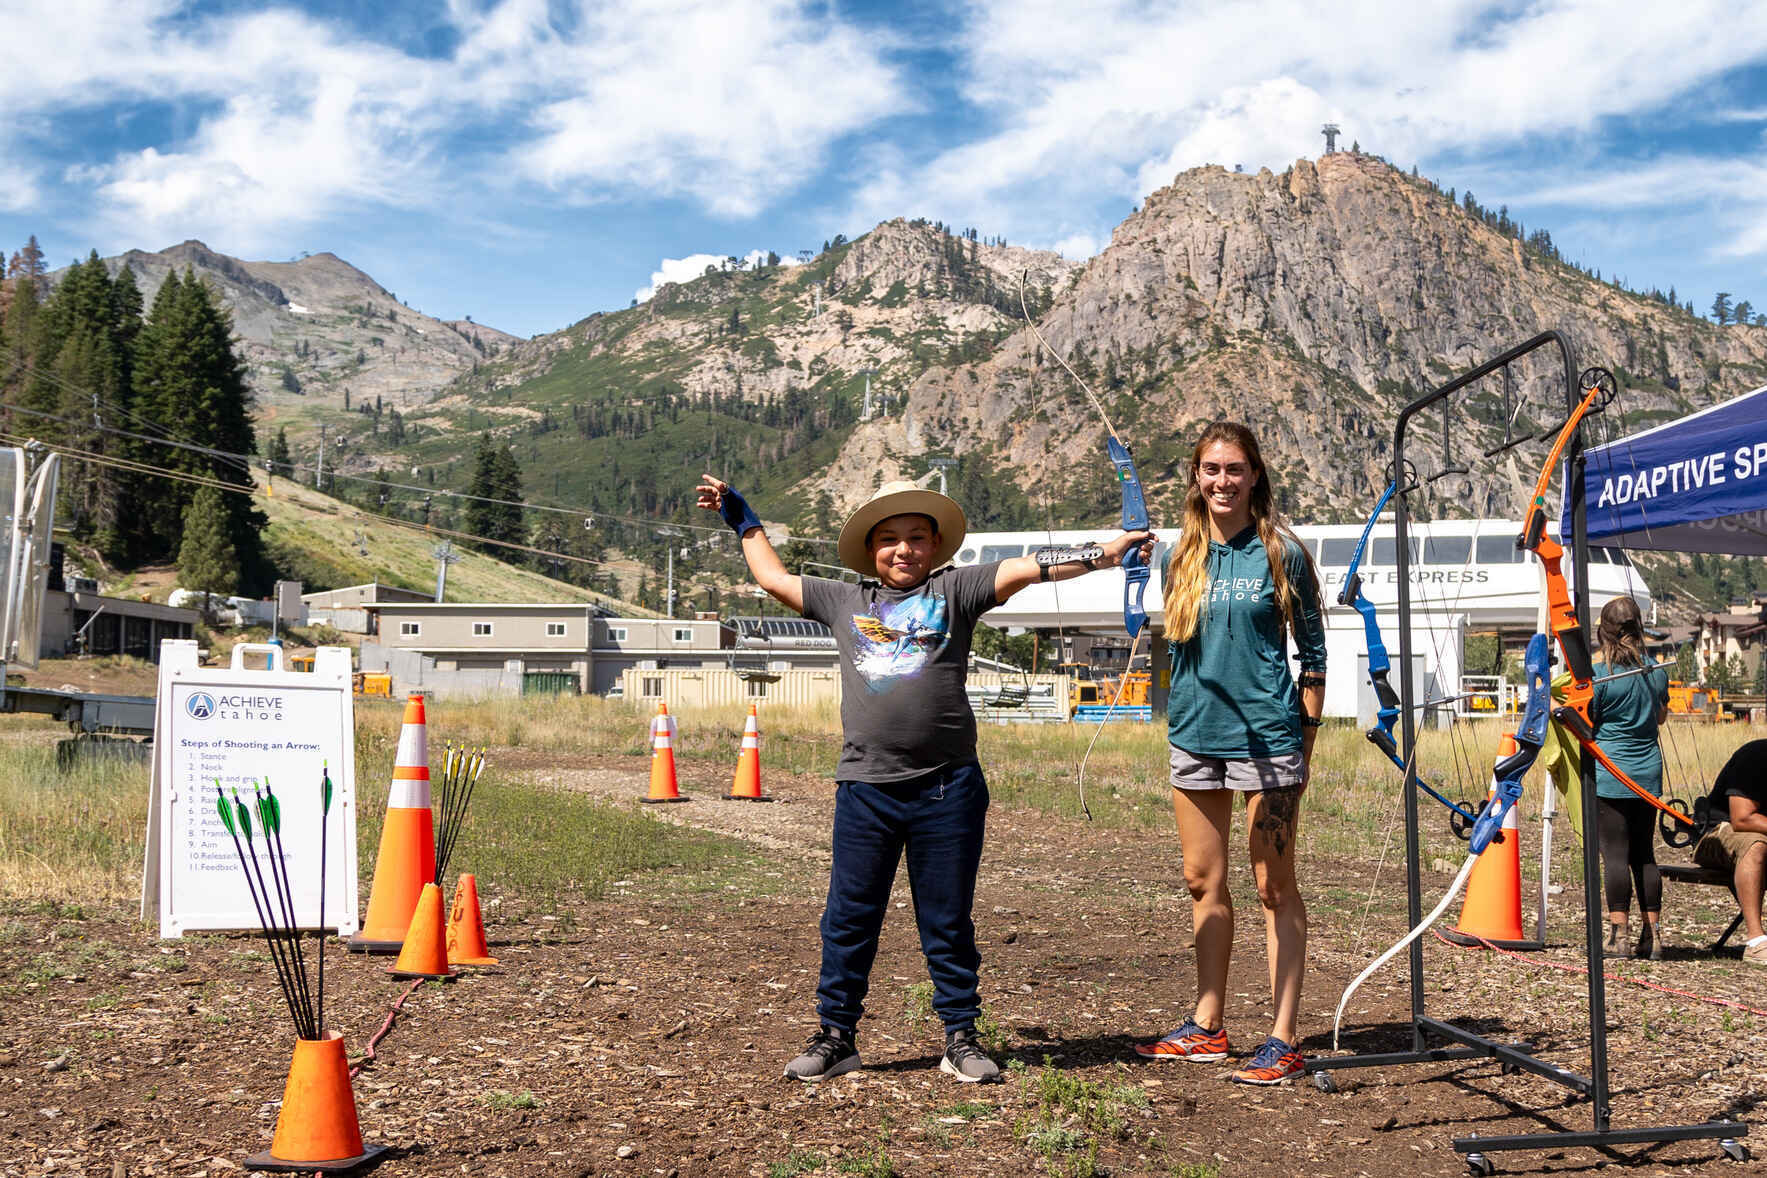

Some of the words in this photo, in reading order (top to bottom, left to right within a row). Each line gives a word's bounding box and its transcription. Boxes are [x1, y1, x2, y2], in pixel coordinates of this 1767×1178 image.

[1598, 451, 1726, 508] ADAPTIVE
[1734, 442, 1767, 480] SP
[1387, 570, 1489, 584] EXPRESS
[219, 696, 283, 709] ACHIEVE
[221, 708, 283, 720] tahoe
[181, 739, 209, 749] Steps
[212, 740, 222, 748] of
[224, 740, 269, 750] Shooting
[286, 742, 321, 751] Arrow:
[200, 753, 227, 761] Stance
[200, 763, 223, 771] Nock
[227, 774, 241, 782] and
[200, 864, 239, 872] Feedback
